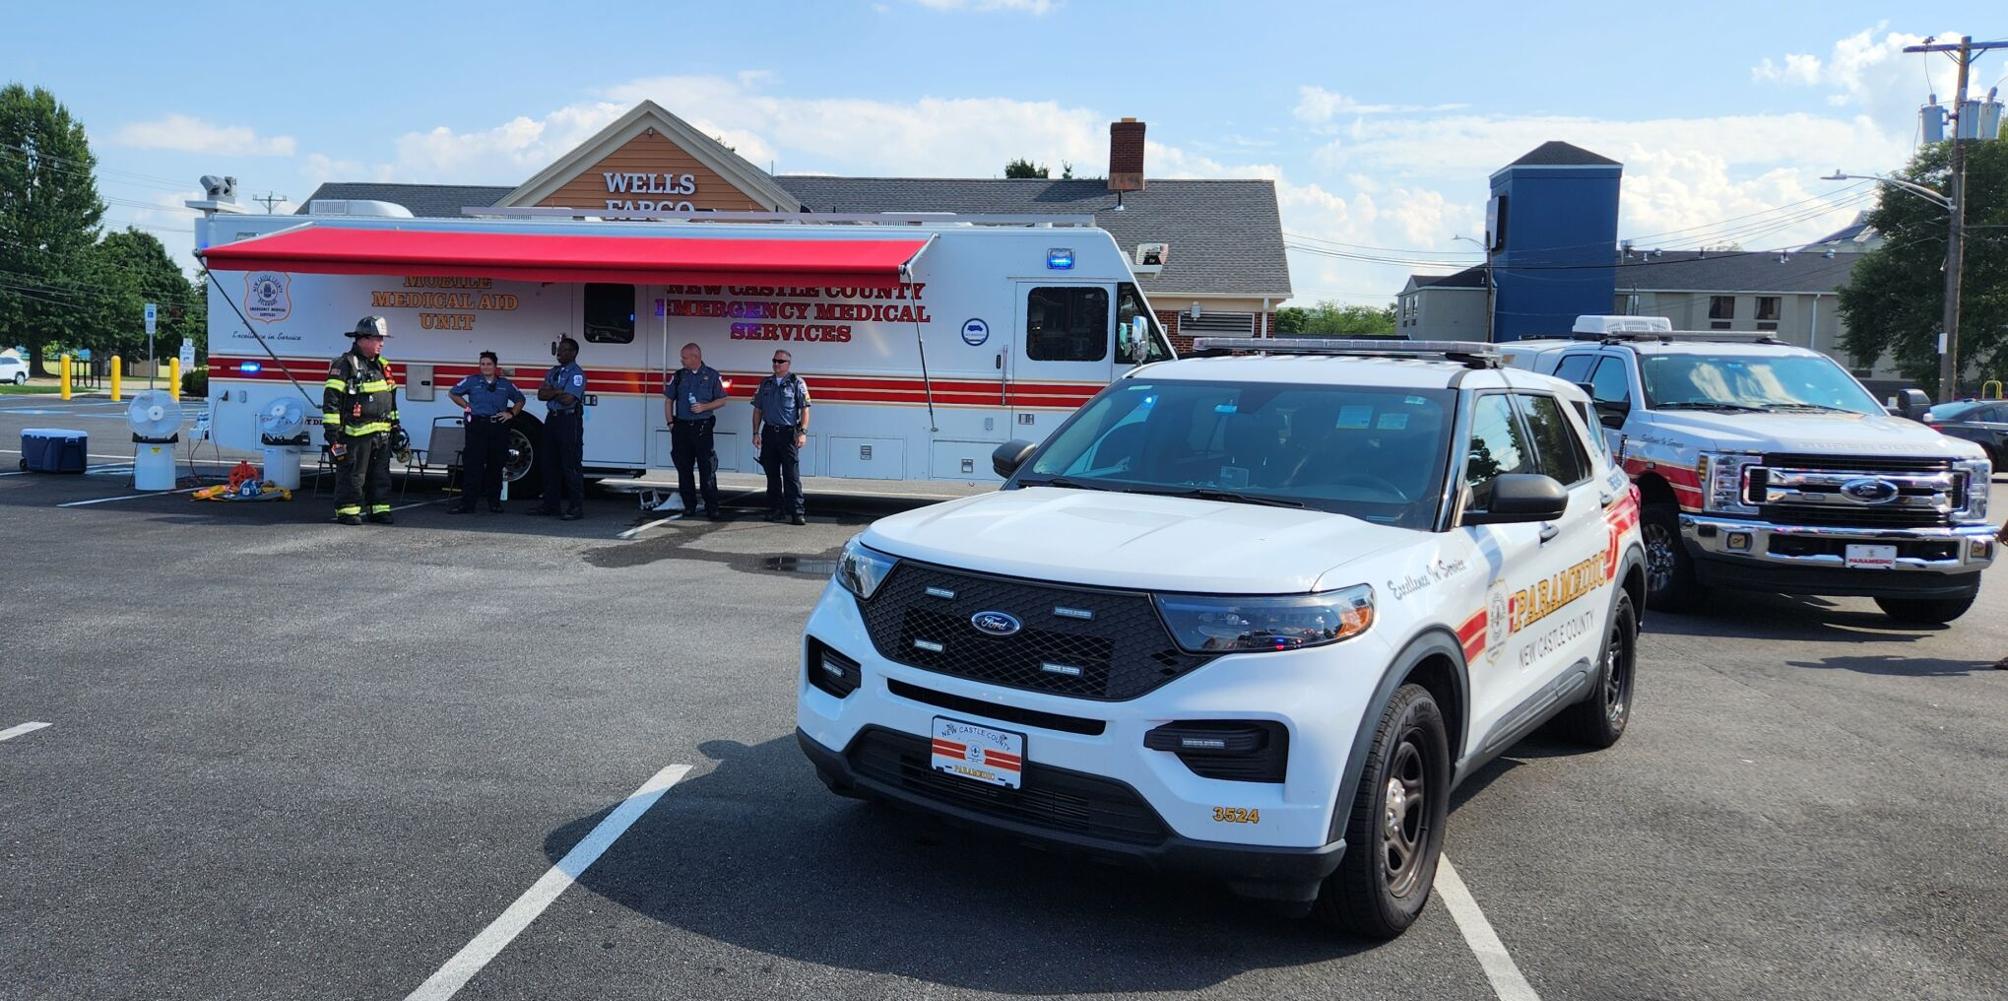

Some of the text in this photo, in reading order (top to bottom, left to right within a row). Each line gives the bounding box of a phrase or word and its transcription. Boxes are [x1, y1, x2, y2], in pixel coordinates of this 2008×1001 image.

[603, 172, 696, 195] WELLS
[404, 276, 492, 289] MOBILE
[824, 283, 926, 300] COUNTY
[371, 291, 519, 311] MEDICAL AID
[656, 299, 931, 323] EMERGENCY MEDICAL
[419, 312, 476, 330] UNIT
[730, 322, 852, 342] SERVICES
[1513, 550, 1606, 633] PARAMEDIC
[980, 615, 1007, 630] Ford
[1519, 644, 1538, 669] NEW
[1539, 626, 1566, 658] CASTLE
[1566, 609, 1594, 641] COUNTY
[941, 726, 1011, 751] NEW CASTLE COUNTY
[1213, 806, 1260, 824] 3524
